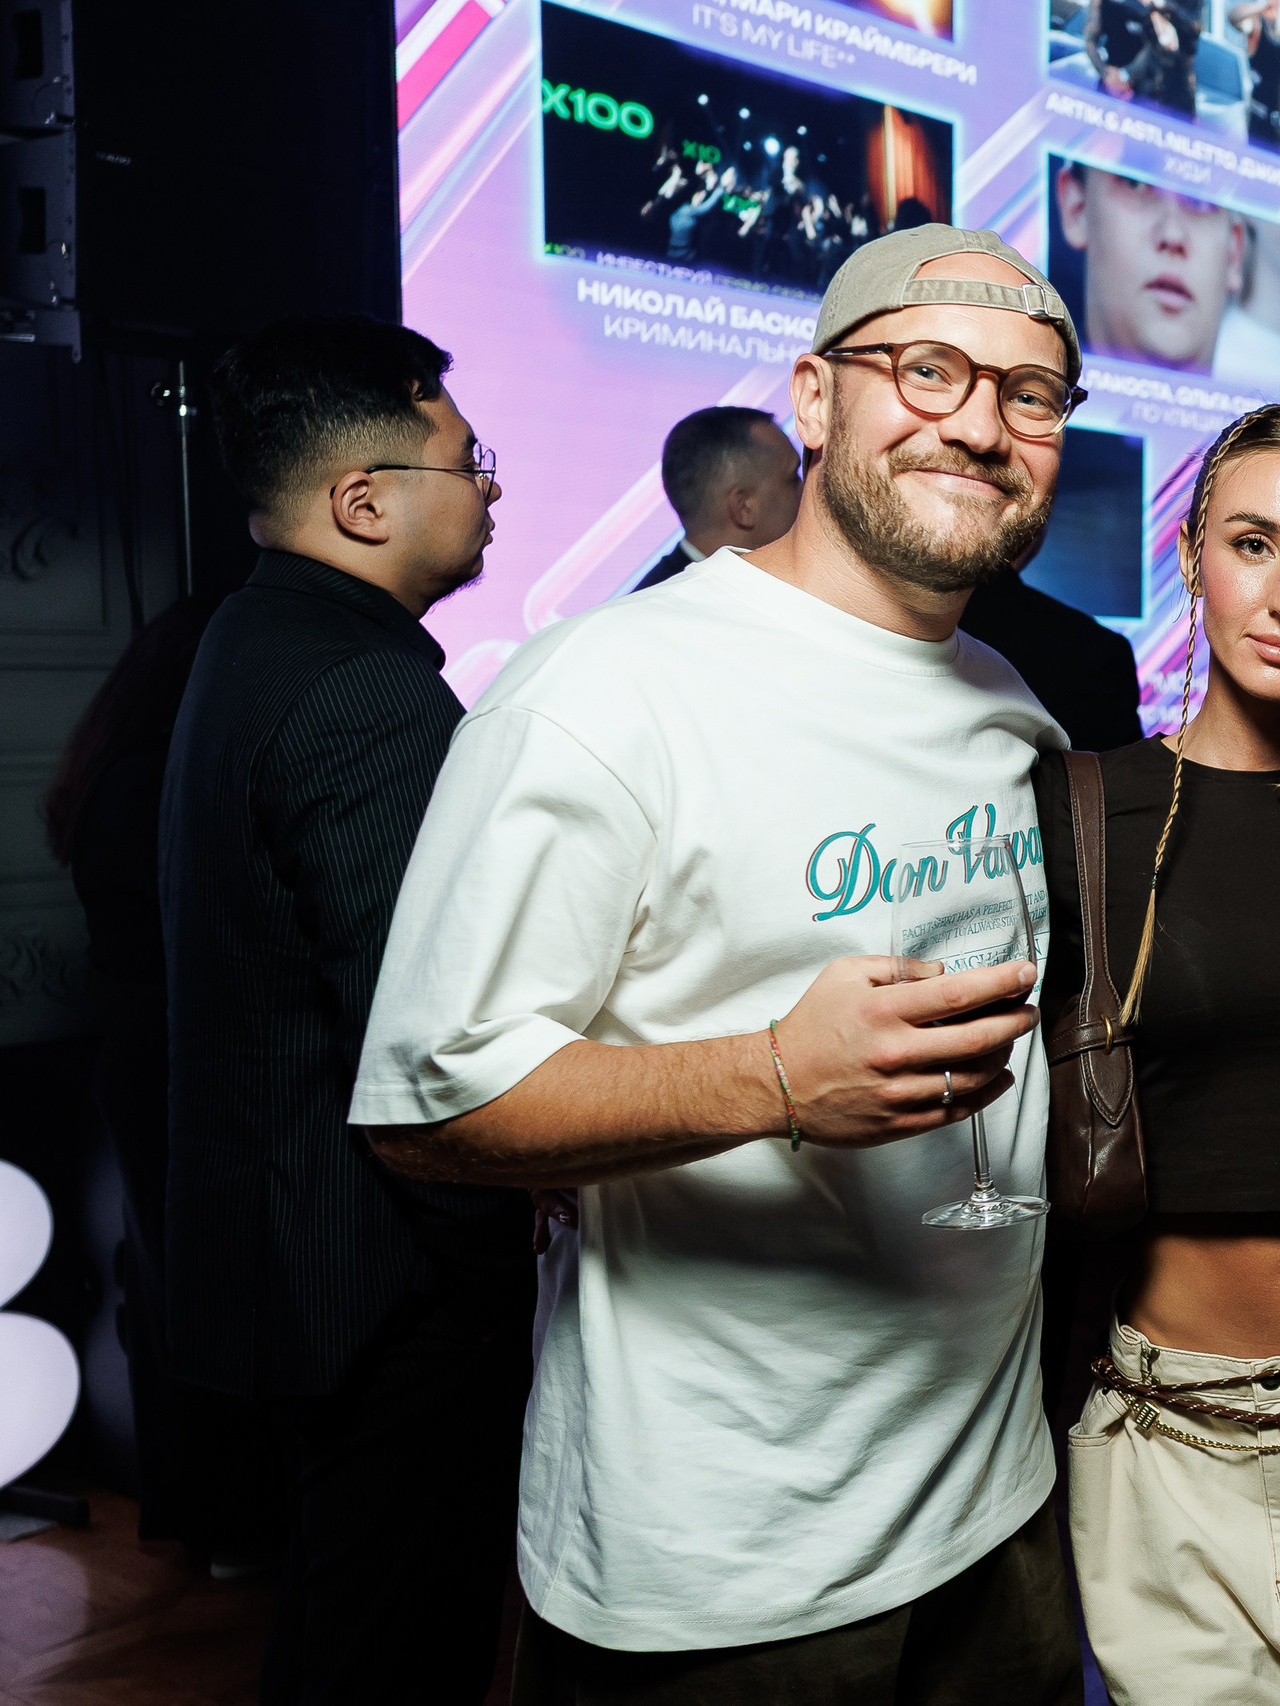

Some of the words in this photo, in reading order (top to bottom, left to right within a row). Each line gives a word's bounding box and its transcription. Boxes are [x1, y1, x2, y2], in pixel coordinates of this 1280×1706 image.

[741, 19, 784, 50] MY
[577, 278, 726, 326] НИКОЛАЙ
[730, 305, 817, 342] БАСКО
[806, 823, 948, 922] Don
[902, 922, 927, 942] EACH
